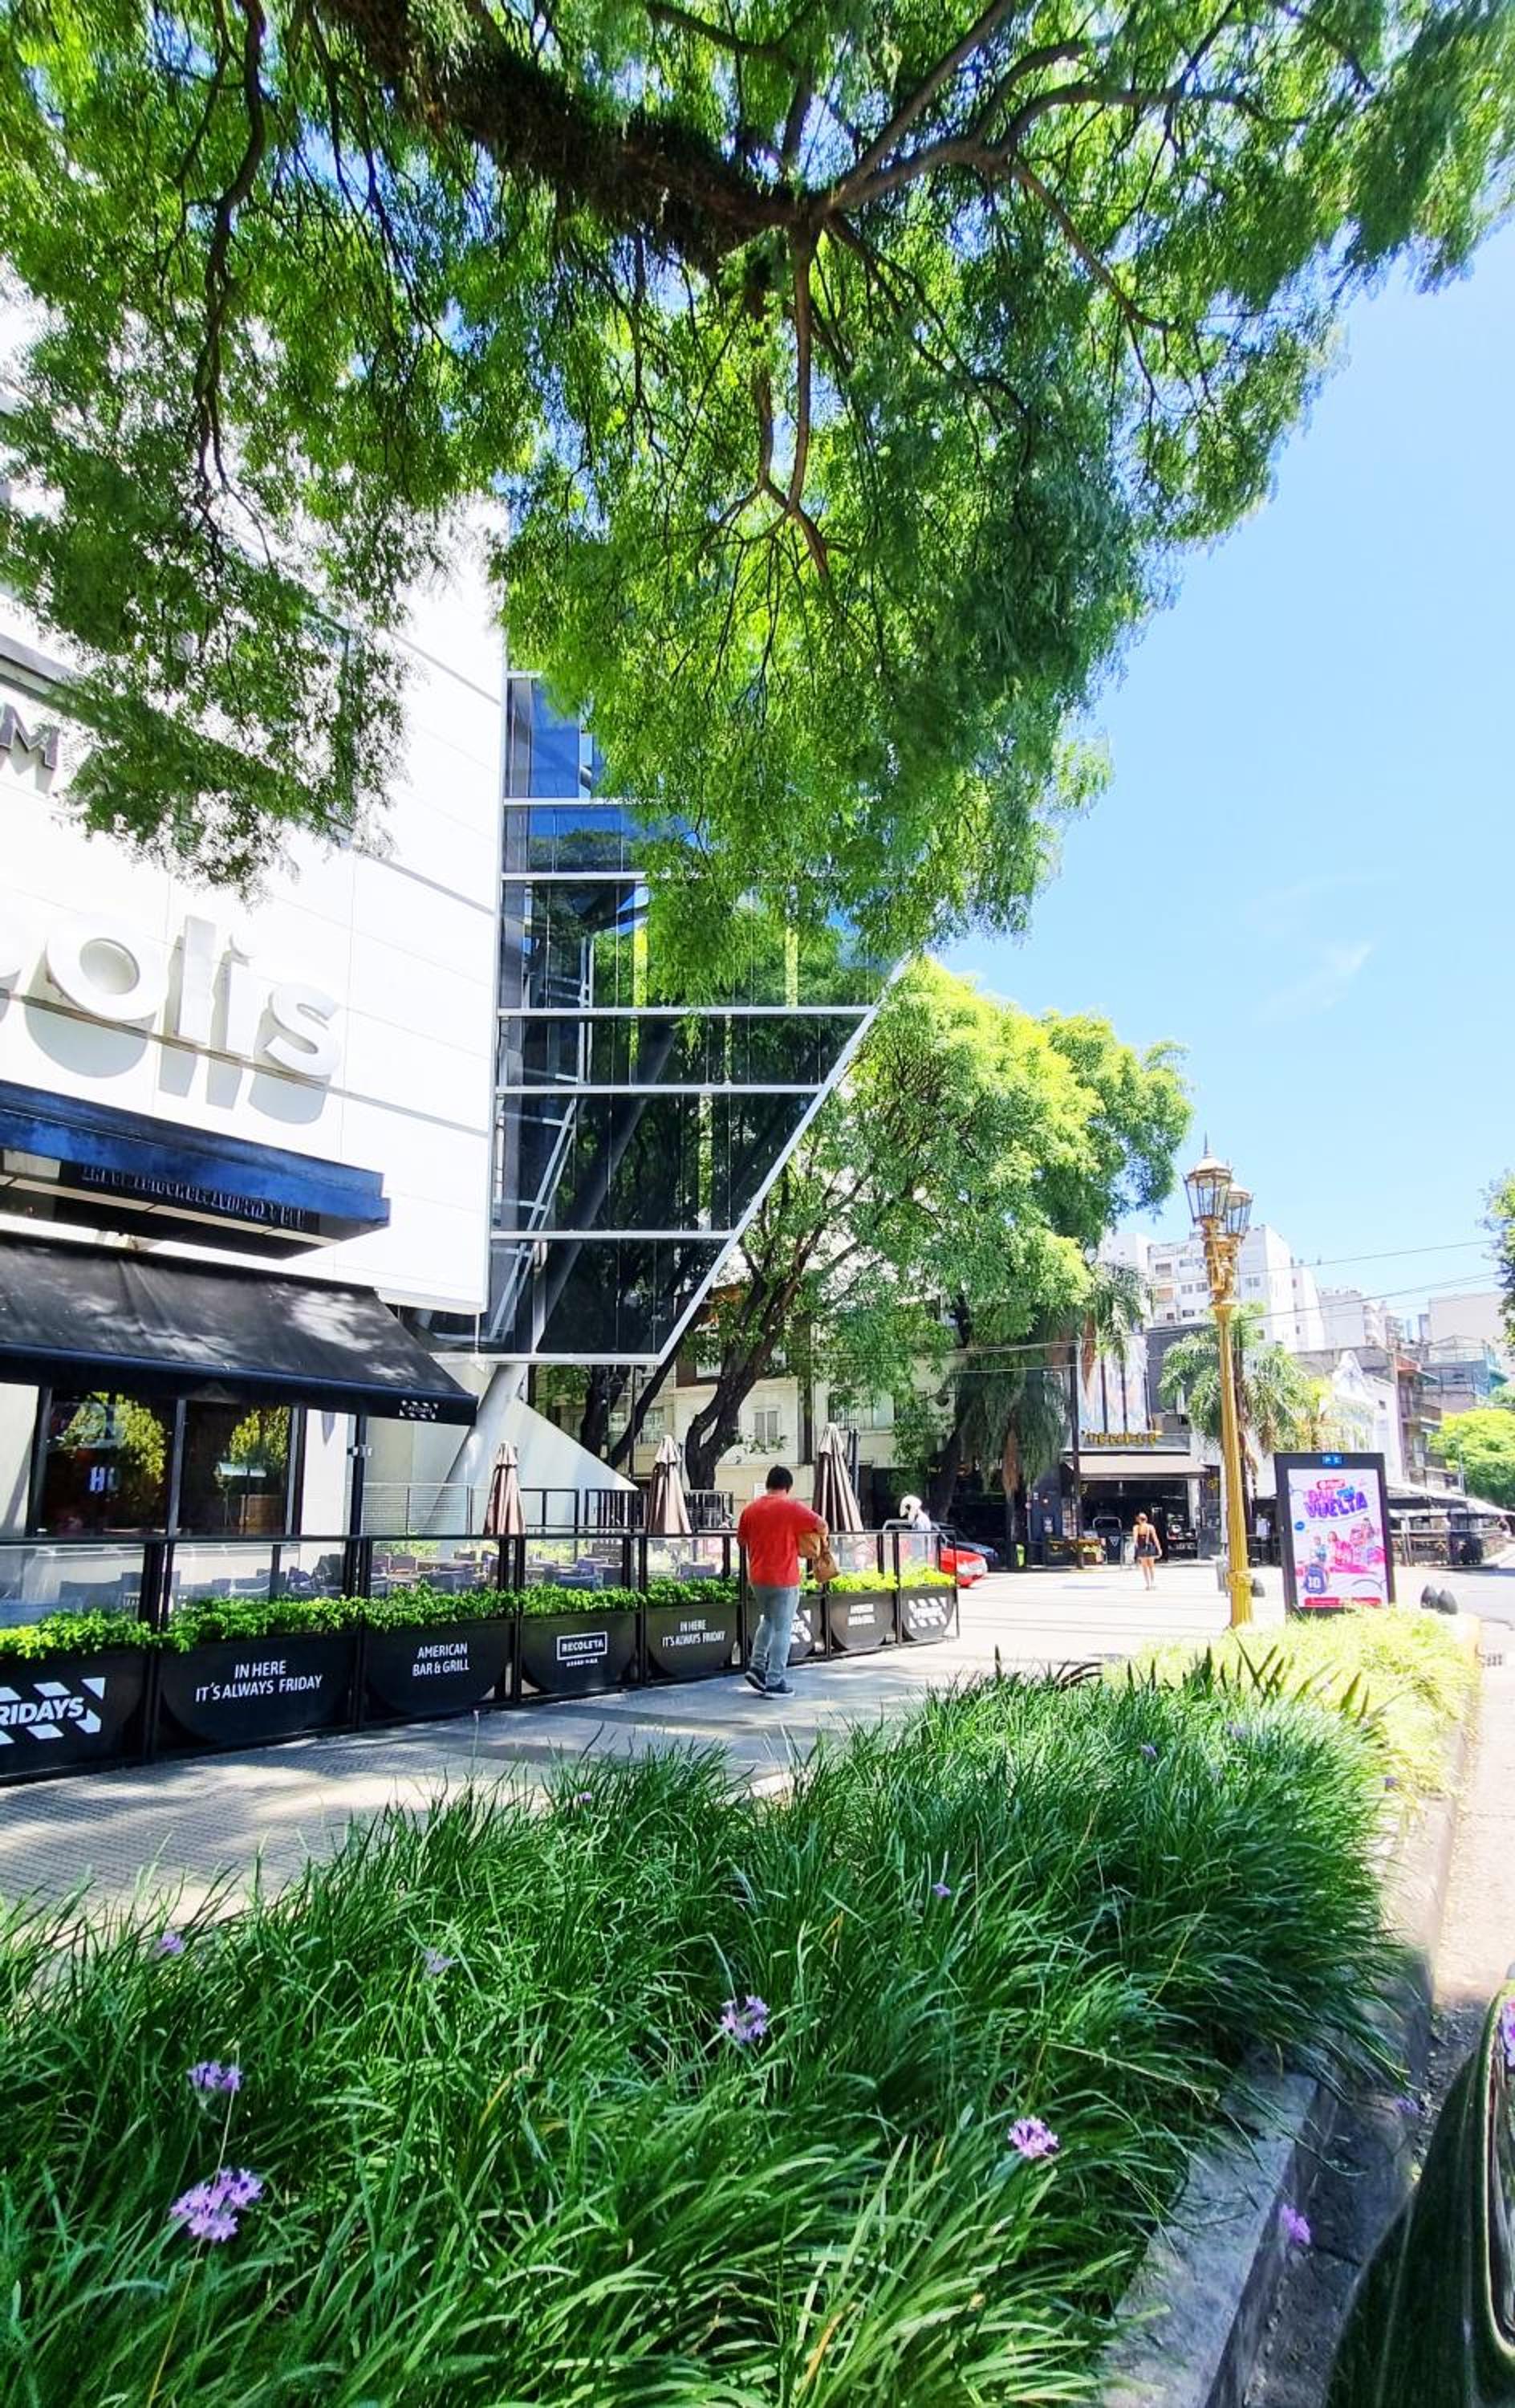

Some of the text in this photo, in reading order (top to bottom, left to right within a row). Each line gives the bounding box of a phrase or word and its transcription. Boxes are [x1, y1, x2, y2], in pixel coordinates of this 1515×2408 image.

[0, 913, 341, 1076] olis
[417, 1642, 468, 1660] AMERICAN
[562, 1639, 603, 1653] RECOLETA
[234, 1660, 286, 1679] IN HERE
[412, 1658, 469, 1677] BAR & GRILL
[221, 1678, 274, 1699] ALWAYS
[278, 1674, 323, 1693] FRIDAY
